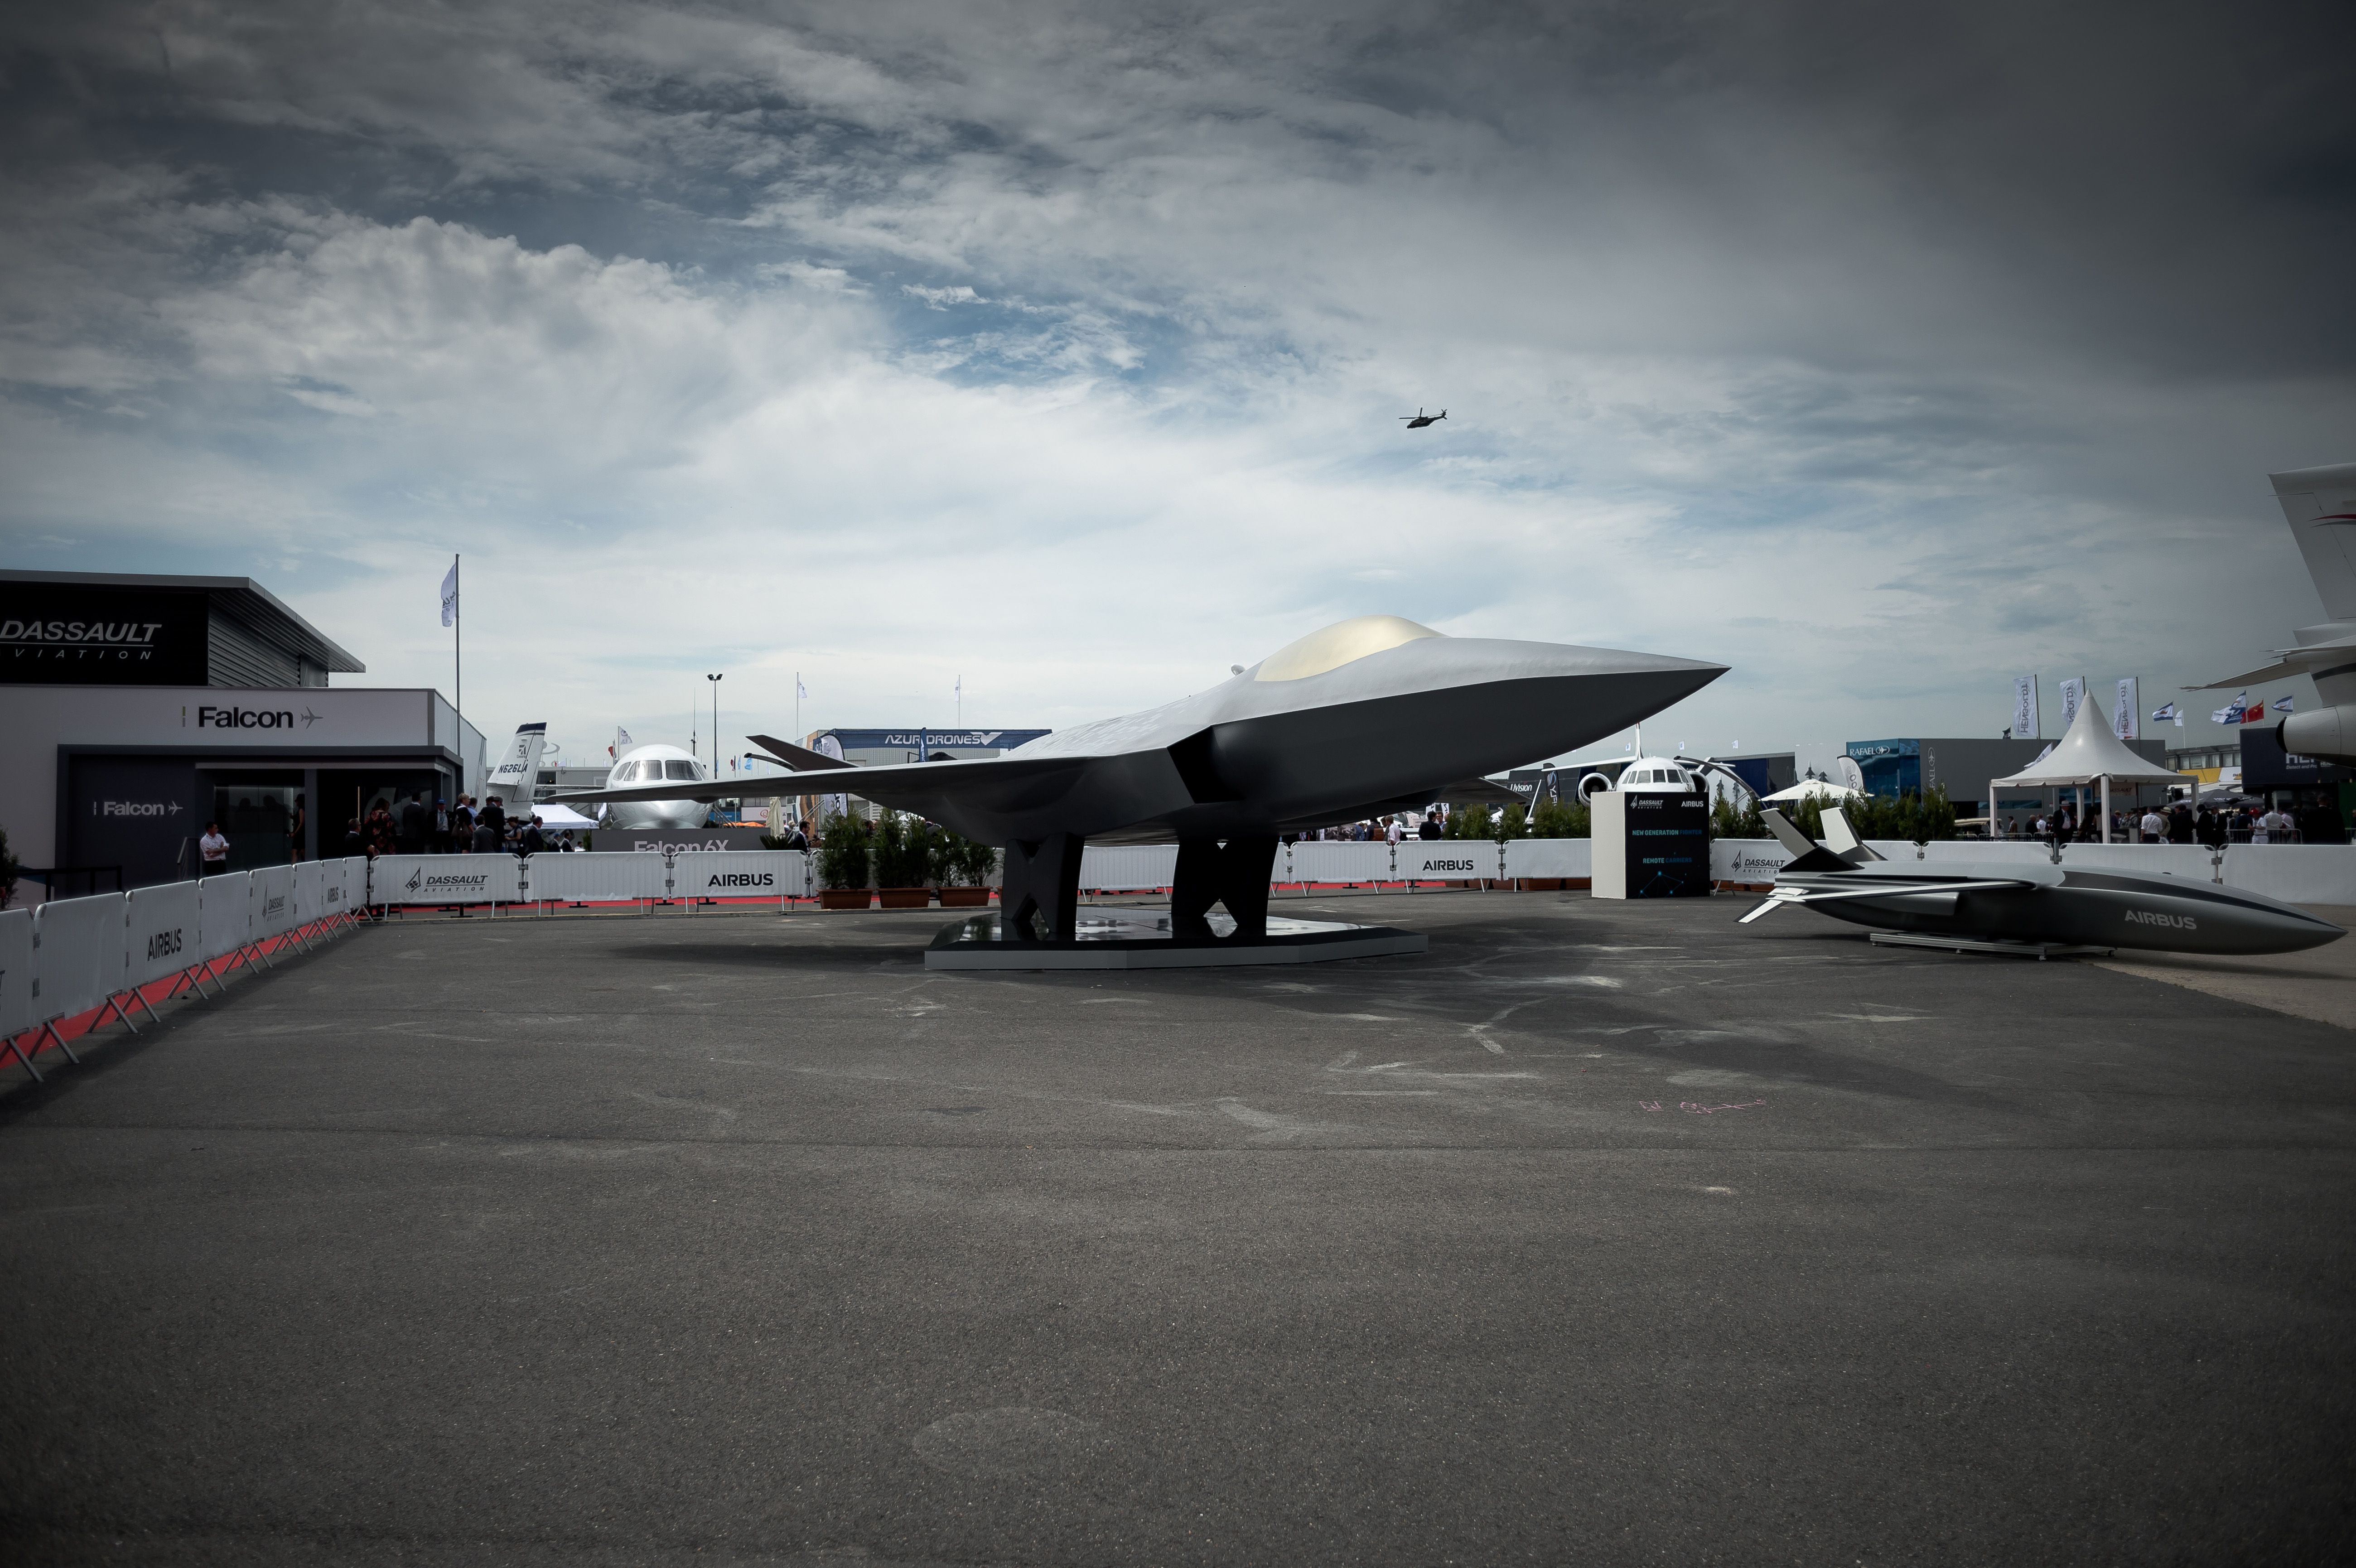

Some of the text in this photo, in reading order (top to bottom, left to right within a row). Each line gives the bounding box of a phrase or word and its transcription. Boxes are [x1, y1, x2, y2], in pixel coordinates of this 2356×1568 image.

[0, 620, 162, 642] DASSAULT
[14, 649, 152, 660] VIATION
[198, 706, 294, 729] Falcon
[885, 735, 981, 744] AZUR DRONES
[1849, 747, 1876, 756] RAFAEL
[498, 763, 528, 773] N626LA
[104, 801, 164, 815] Falcon
[634, 839, 729, 856] Falcon 6X
[1422, 859, 1474, 871] AIRBUS
[1744, 859, 1785, 867] DASSAULT
[426, 875, 488, 885] DASSAULT
[708, 873, 774, 887] AIRBUS
[327, 886, 339, 904] AIRBUS
[268, 895, 285, 911] DASSAULT
[2124, 910, 2197, 930] AIRBUS
[147, 928, 182, 961] AIRBUS
